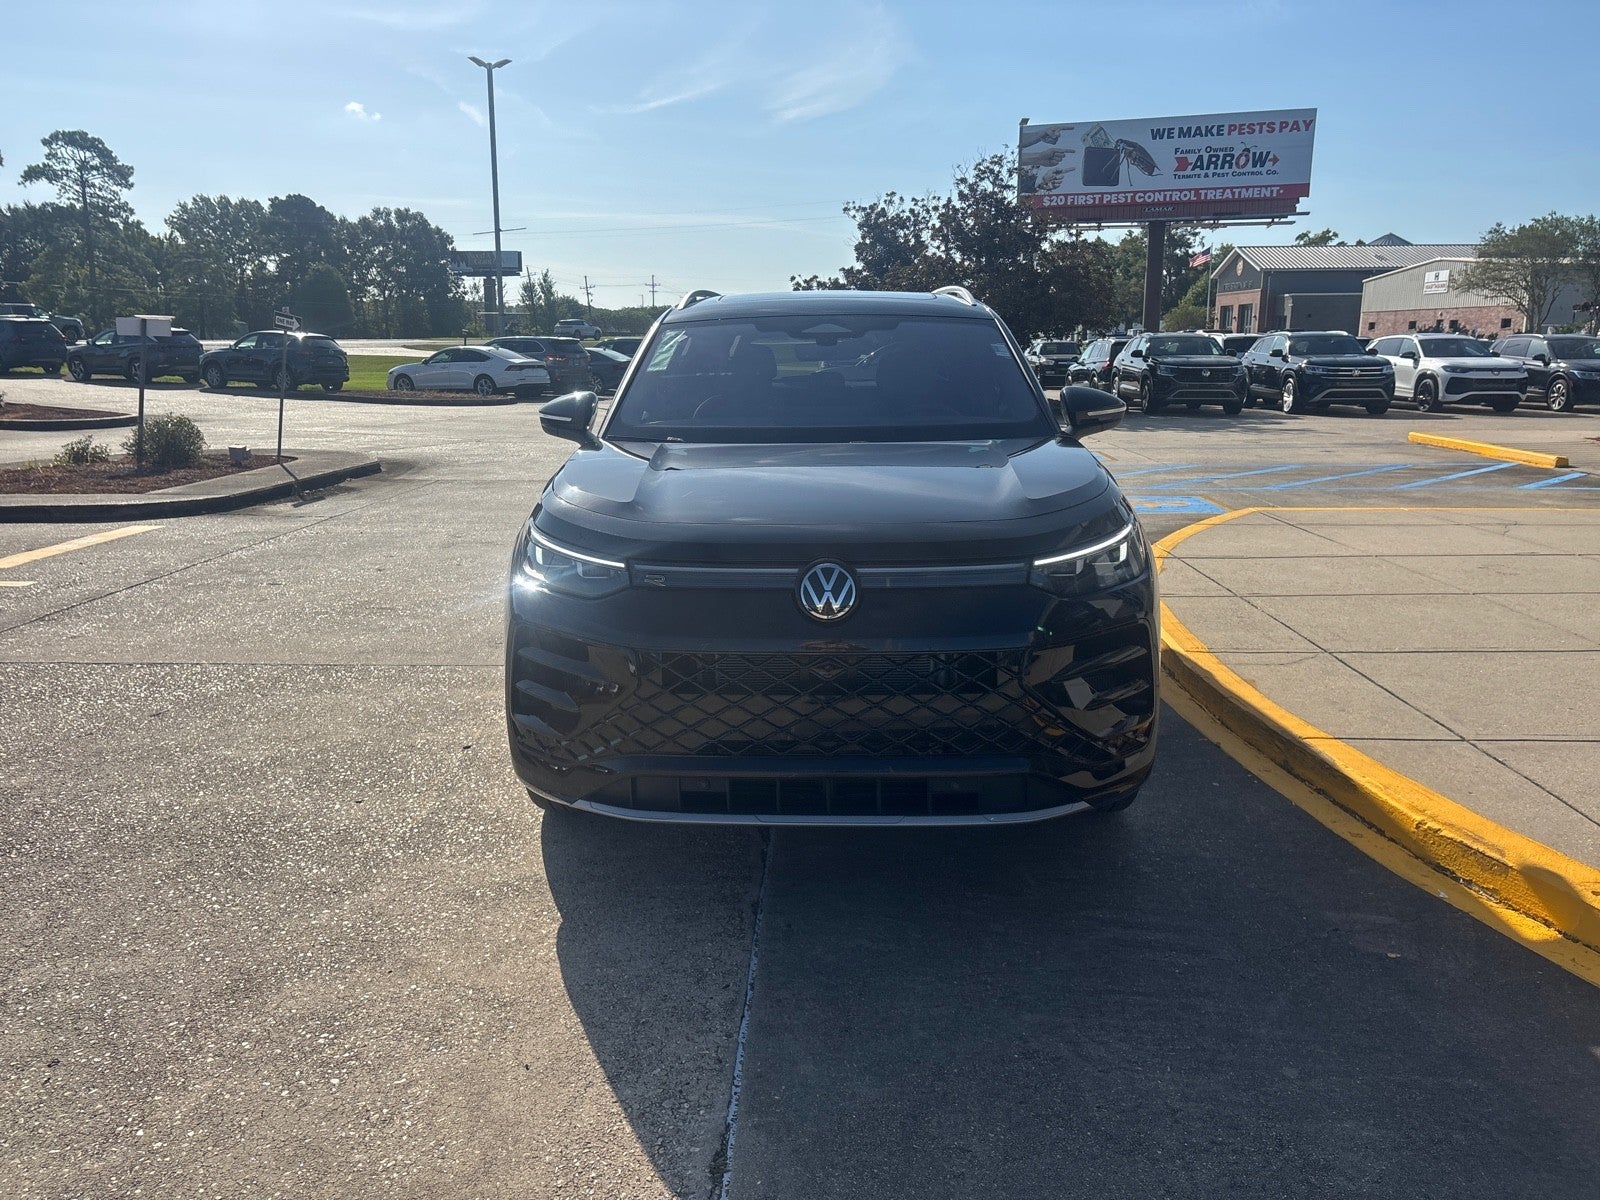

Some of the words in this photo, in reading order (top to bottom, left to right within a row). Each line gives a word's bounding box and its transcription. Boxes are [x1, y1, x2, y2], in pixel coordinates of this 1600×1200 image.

[1150, 127, 1175, 140] WE
[1177, 124, 1225, 139] MAKE
[1227, 121, 1276, 136] PESTS
[1278, 119, 1314, 133] PAY
[1174, 147, 1201, 155] FAMILY
[1204, 145, 1234, 154] OWNED
[1190, 150, 1271, 171] ARROW
[1173, 172, 1201, 180] TERMITE
[1231, 169, 1263, 177] CONTROL
[1042, 195, 1066, 207] $20
[1067, 193, 1102, 205] FIRST
[1103, 192, 1133, 204] PEST
[1135, 189, 1197, 203] CONTROL
[801, 564, 855, 618] VW
